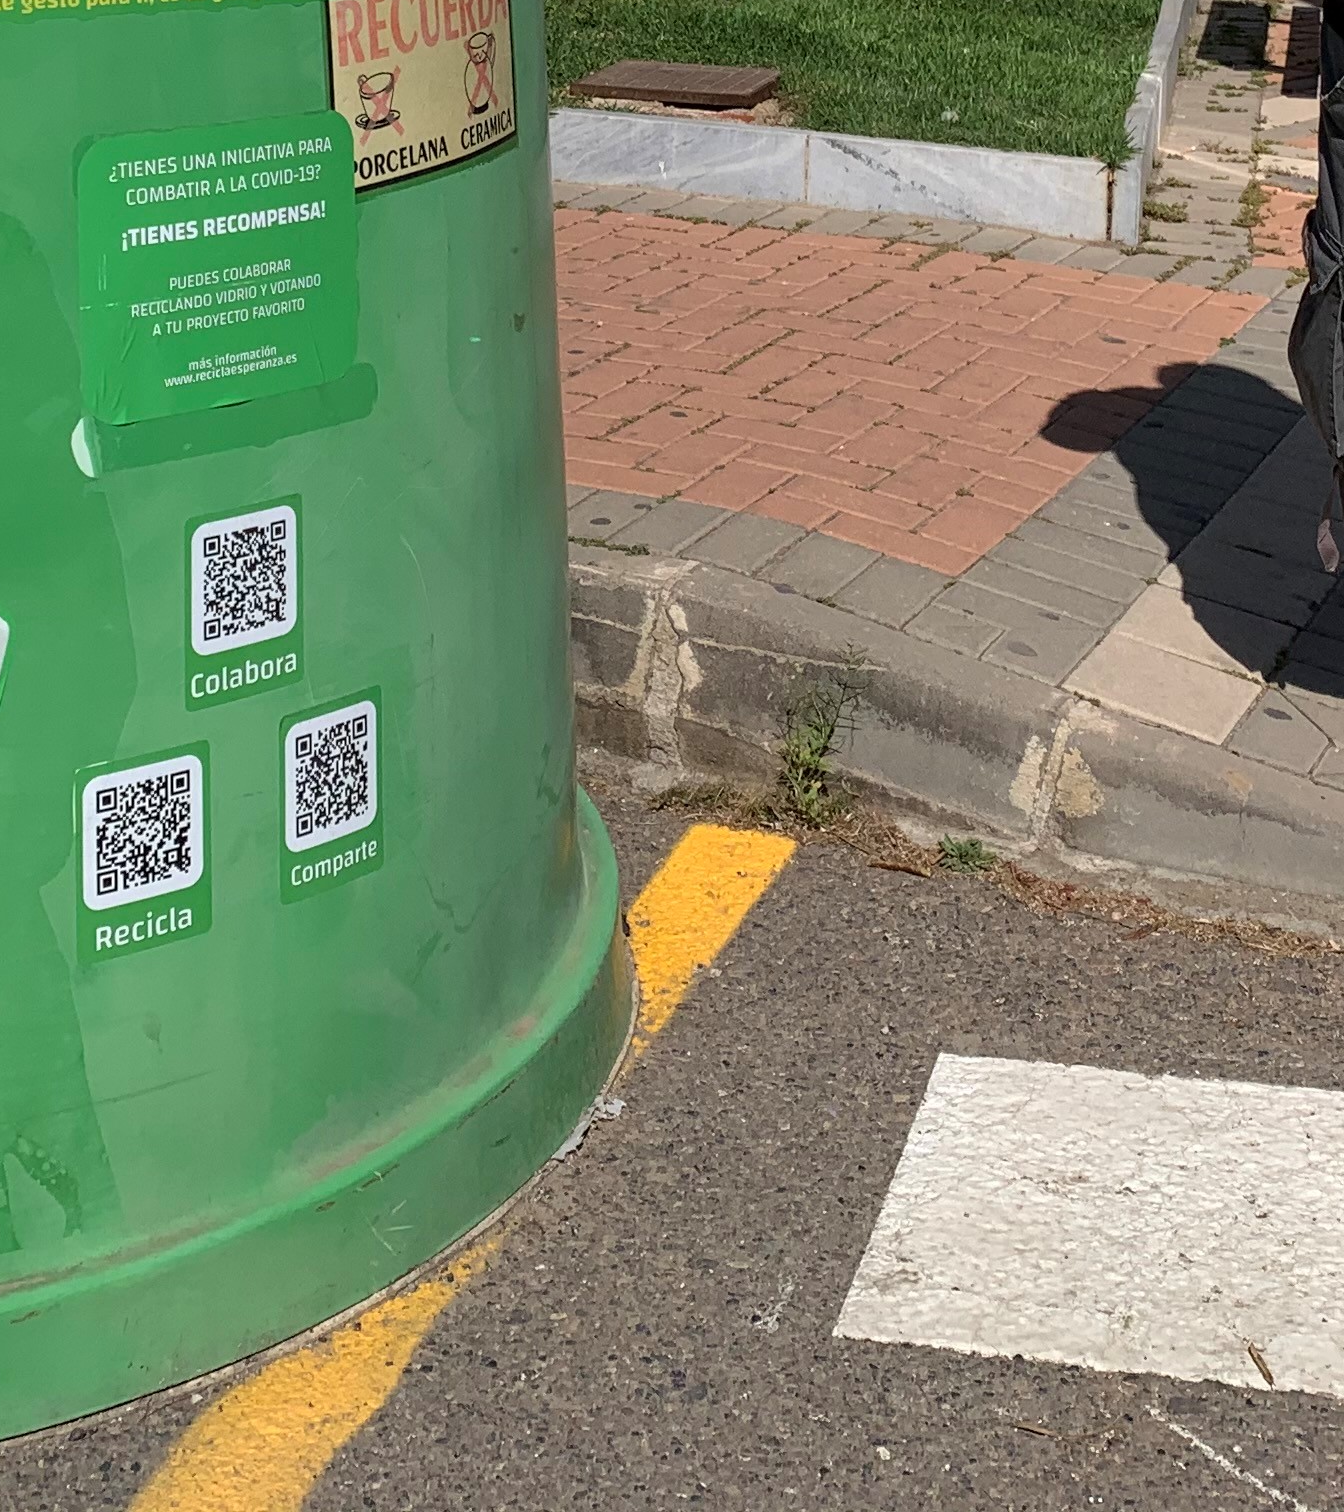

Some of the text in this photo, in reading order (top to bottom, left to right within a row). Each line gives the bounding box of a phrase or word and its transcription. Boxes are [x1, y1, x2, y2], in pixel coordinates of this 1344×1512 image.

[109, 136, 333, 183] ¿TIENES UNA INICIATIVA PARA
[353, 108, 513, 181] ORCELANA CERAMICA
[125, 164, 322, 206] COMBATIR A LA COVID-19?
[121, 199, 326, 252] ¡TIENES RECOMPENSA!
[130, 272, 322, 318] RECICLANDO VIDRIO Y VOTANDO
[169, 258, 292, 292] PUEDES COLABORAR
[152, 297, 306, 337] A TU PROYECTO FAVORITO
[164, 353, 298, 387] www.reciclaesperanza.es
[188, 345, 278, 372] más información
[190, 651, 297, 699] Colabora
[290, 837, 378, 887] Comparte
[95, 906, 193, 952] Recicla
